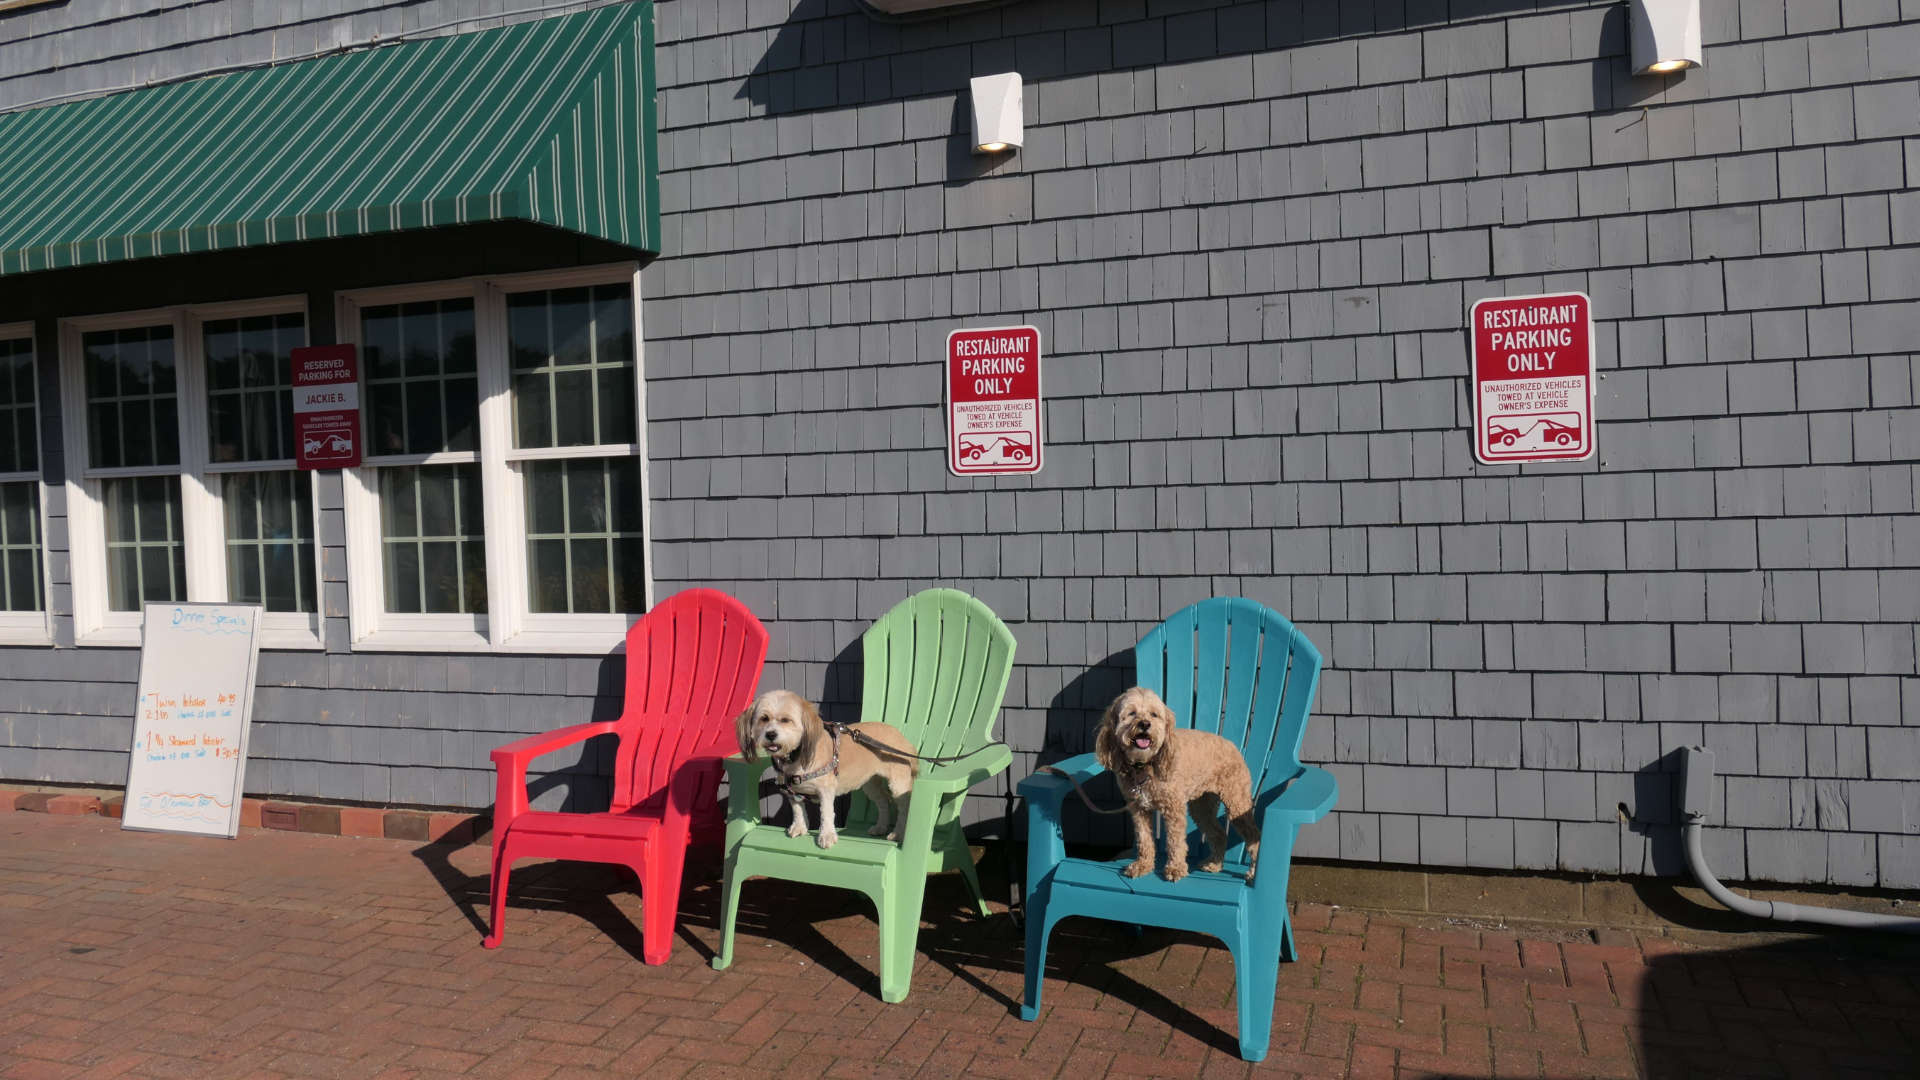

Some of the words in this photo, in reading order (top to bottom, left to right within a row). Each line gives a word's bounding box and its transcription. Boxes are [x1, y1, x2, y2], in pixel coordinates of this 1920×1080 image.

[1483, 304, 1578, 329] RESTAURANT
[1491, 328, 1572, 351] PARKING
[956, 336, 1030, 357] RESTAURANT
[304, 359, 344, 370] RESERVED
[962, 357, 1025, 376] PARKING
[1507, 351, 1556, 372] ONLY
[298, 370, 333, 382] PARKING
[334, 369, 351, 379] FOR
[974, 377, 1013, 395] ONLY
[1484, 382, 1542, 393] UNAUTHORIZED
[1545, 380, 1582, 389] VEHICLES
[305, 393, 336, 405] JACKIE
[337, 392, 346, 403] B.
[1497, 392, 1522, 401] TOWED
[1525, 392, 1534, 400] AT
[1537, 390, 1569, 399] VEHICLE
[956, 404, 1002, 413] UNAUTHORIZED
[1003, 403, 1033, 411] VEHICLES
[1498, 402, 1532, 411] OWNER'S
[1534, 399, 1569, 409] EXPENSE
[997, 411, 1023, 419] VEHICLE
[995, 420, 1023, 428] EXPENSE
